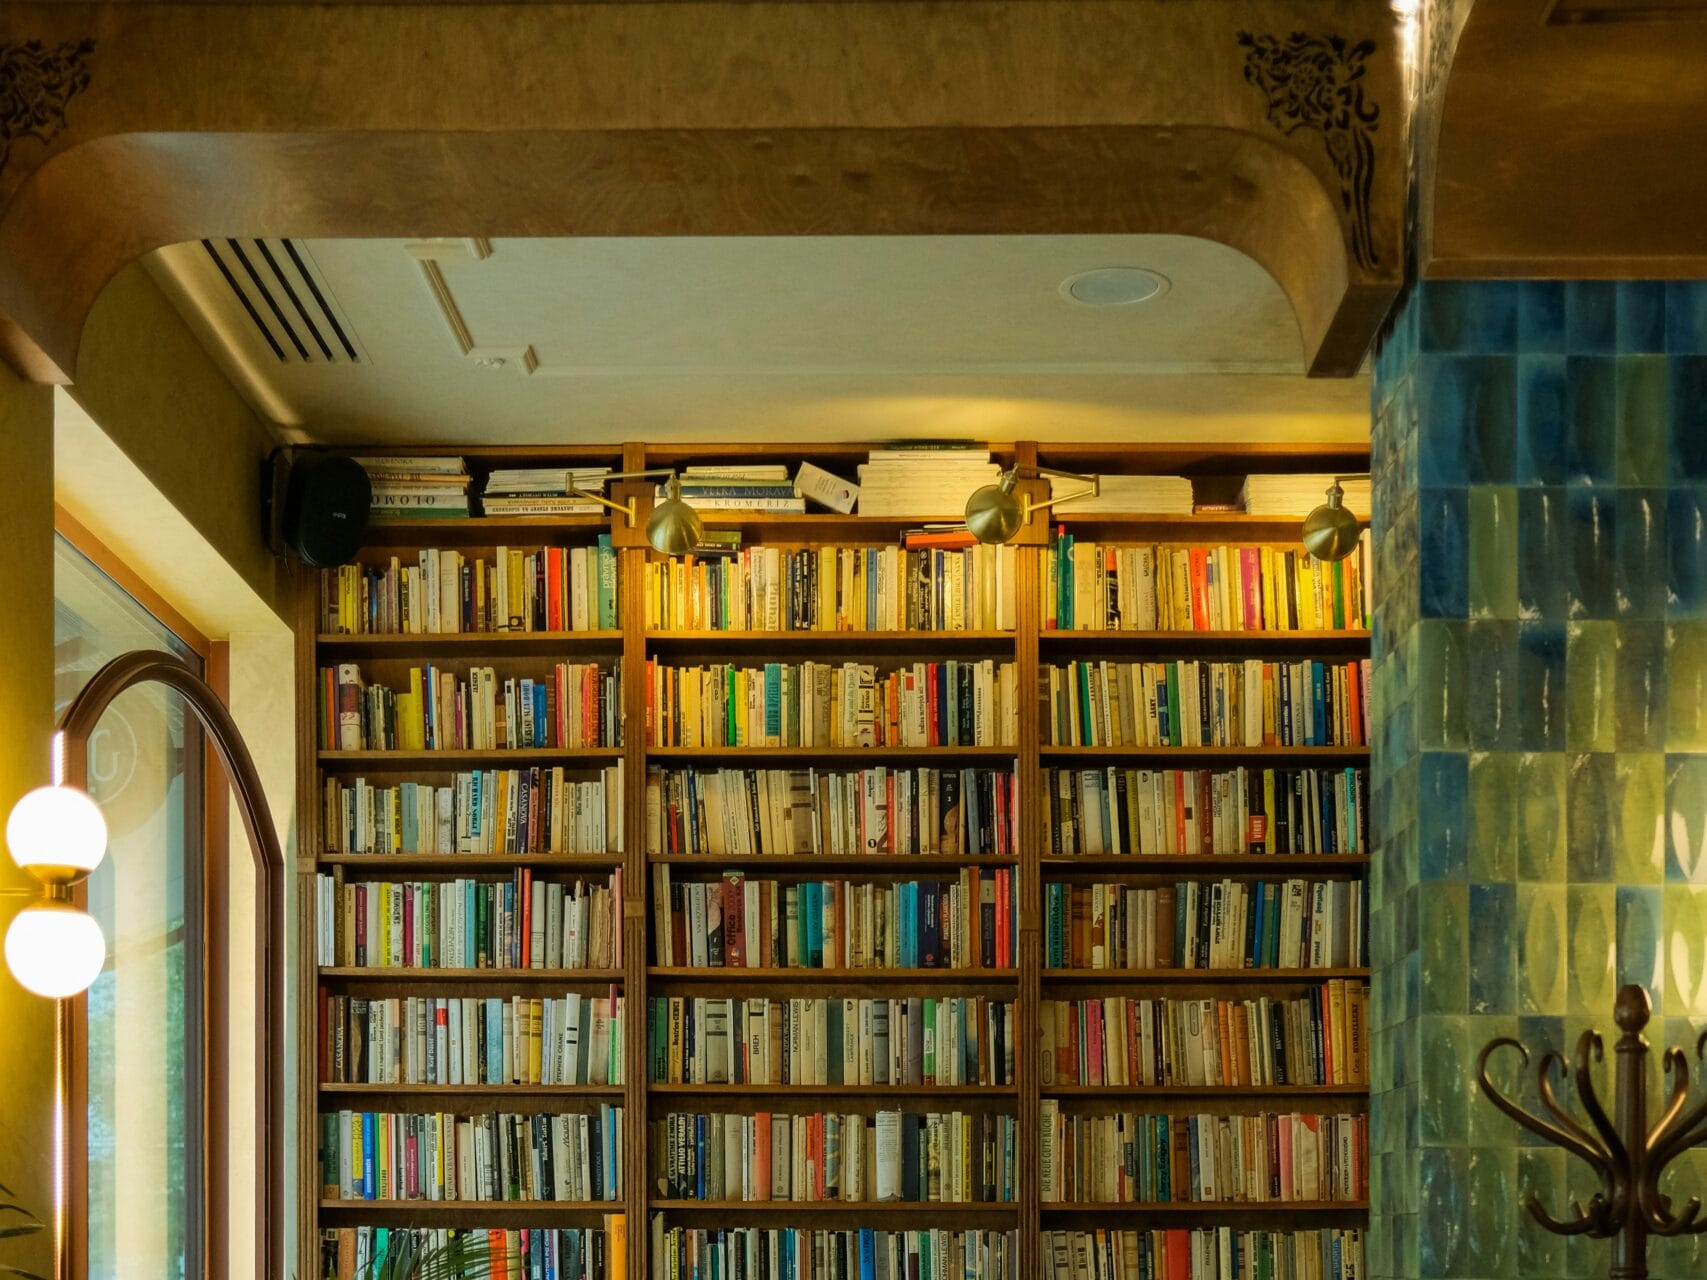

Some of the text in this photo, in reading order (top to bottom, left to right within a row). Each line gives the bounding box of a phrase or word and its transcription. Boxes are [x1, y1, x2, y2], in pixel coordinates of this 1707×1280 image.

[520, 783, 528, 825] CASANOVA
[726, 914, 736, 946] Office
[336, 1026, 344, 1068] CASANOVA
[672, 1021, 680, 1046] Beatrice
[678, 1116, 686, 1175] ATTILIO VERALDI
[1041, 1138, 1051, 1158] GUTE
[1042, 1159, 1051, 1179] NEUE
[1042, 1180, 1051, 1192] DIE
